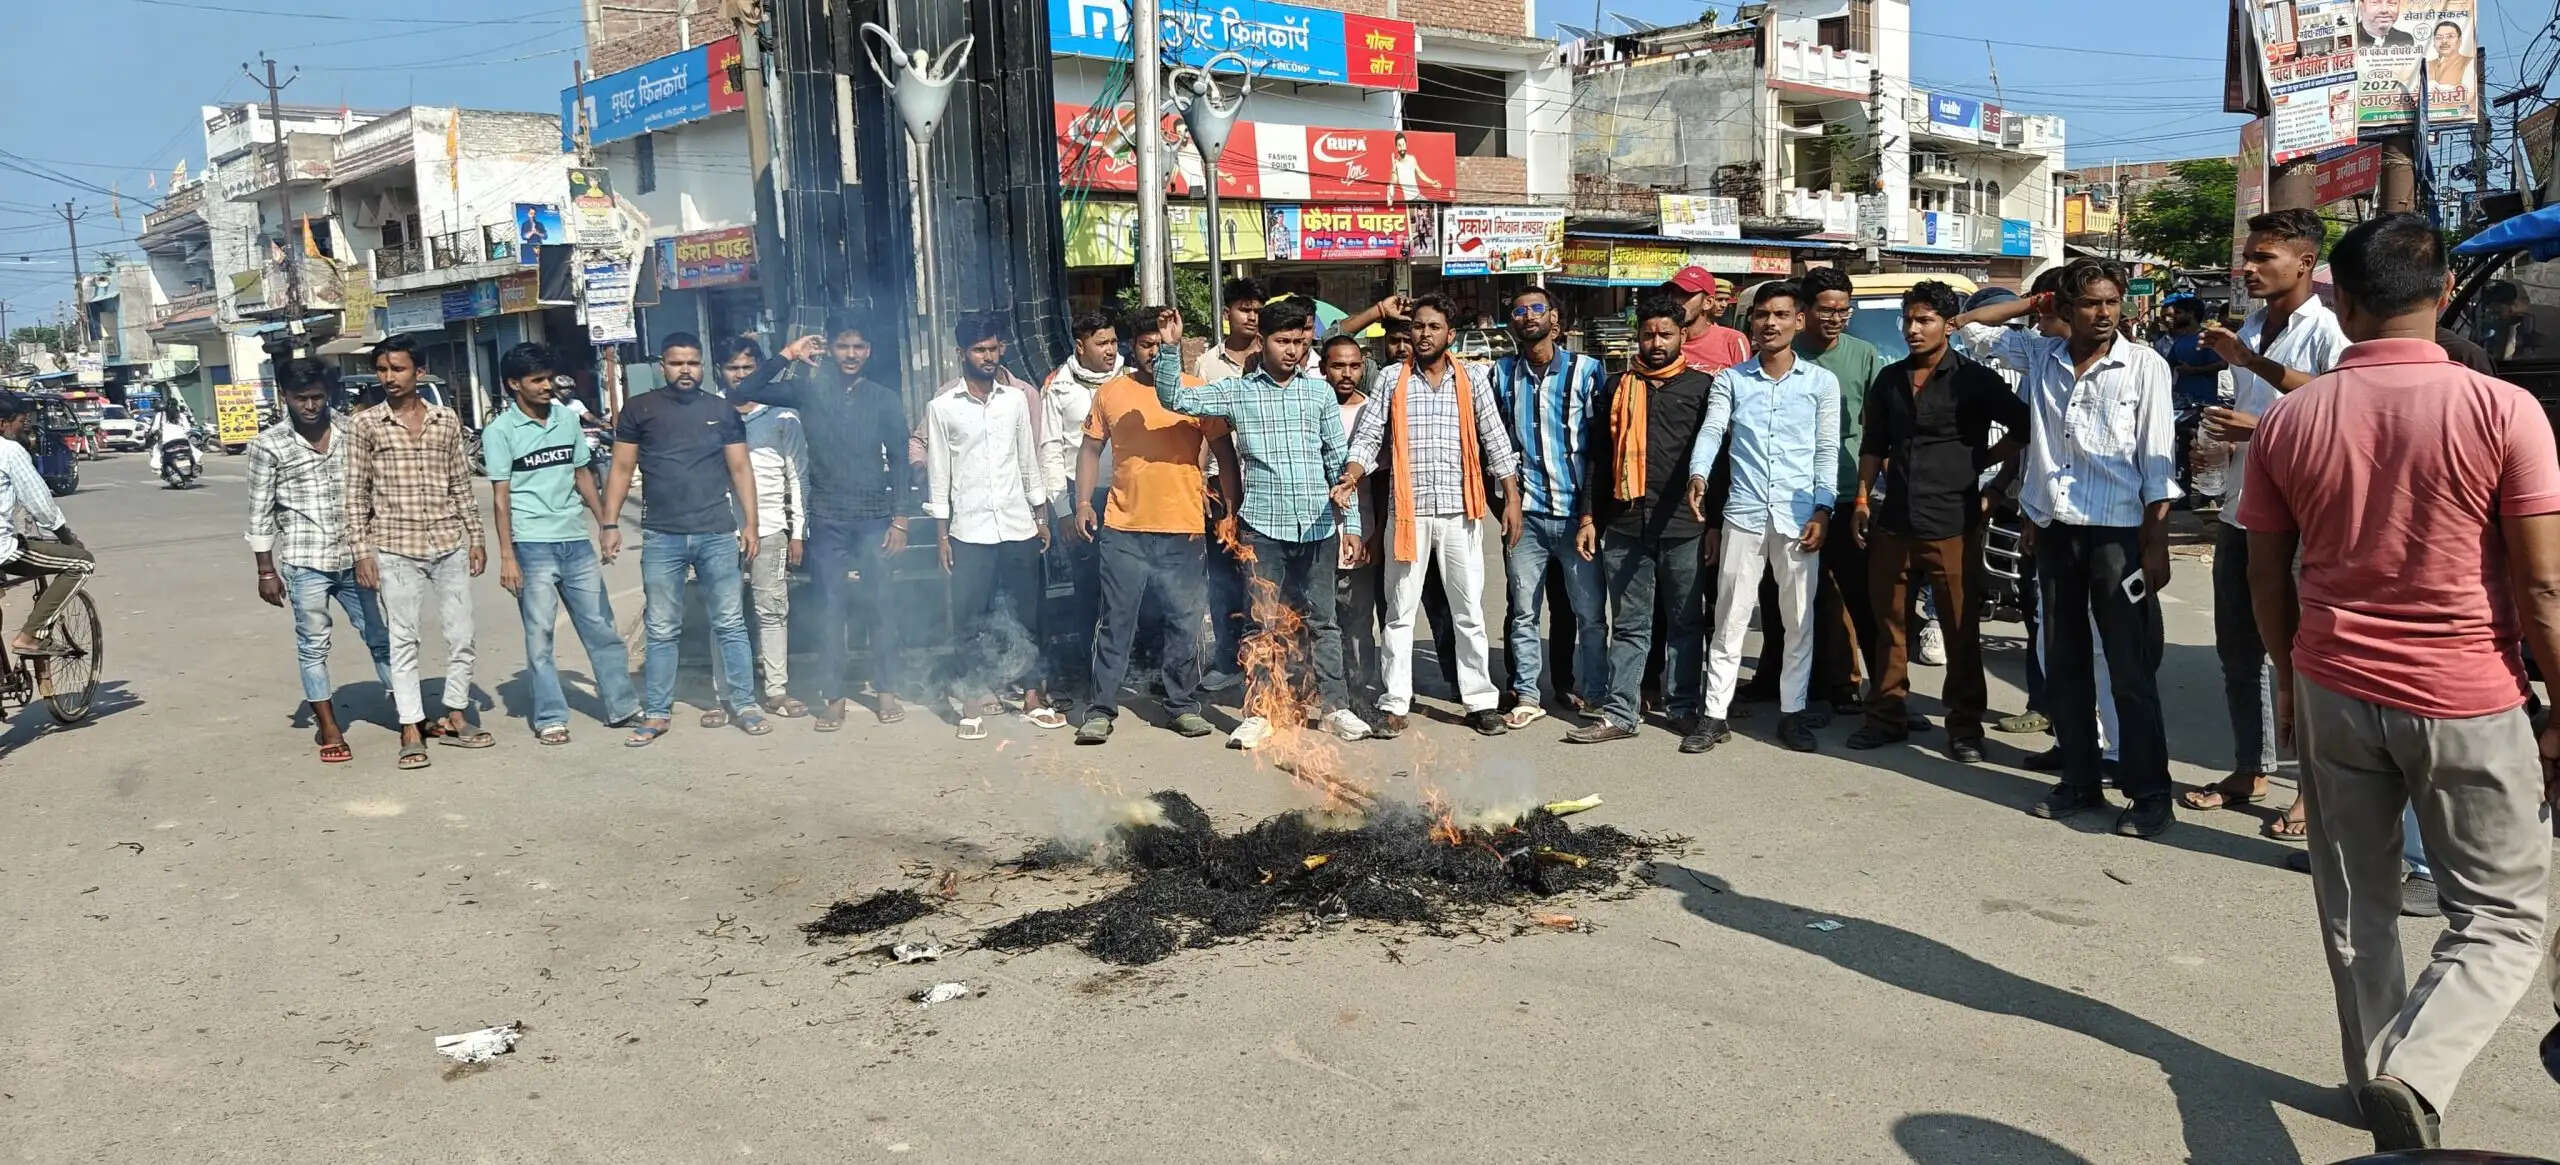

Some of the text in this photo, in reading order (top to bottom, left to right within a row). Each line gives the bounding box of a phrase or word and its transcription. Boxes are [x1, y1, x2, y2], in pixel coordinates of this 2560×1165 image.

[1365, 28, 1396, 51] गोल्ड
[1370, 54, 1395, 75] लोन
[2362, 81, 2399, 91] 2027
[1326, 137, 1367, 152] RUPA
[1268, 153, 1297, 161] FASHION
[1303, 207, 1352, 231] फैशन
[1457, 219, 1492, 236] प्रकाश
